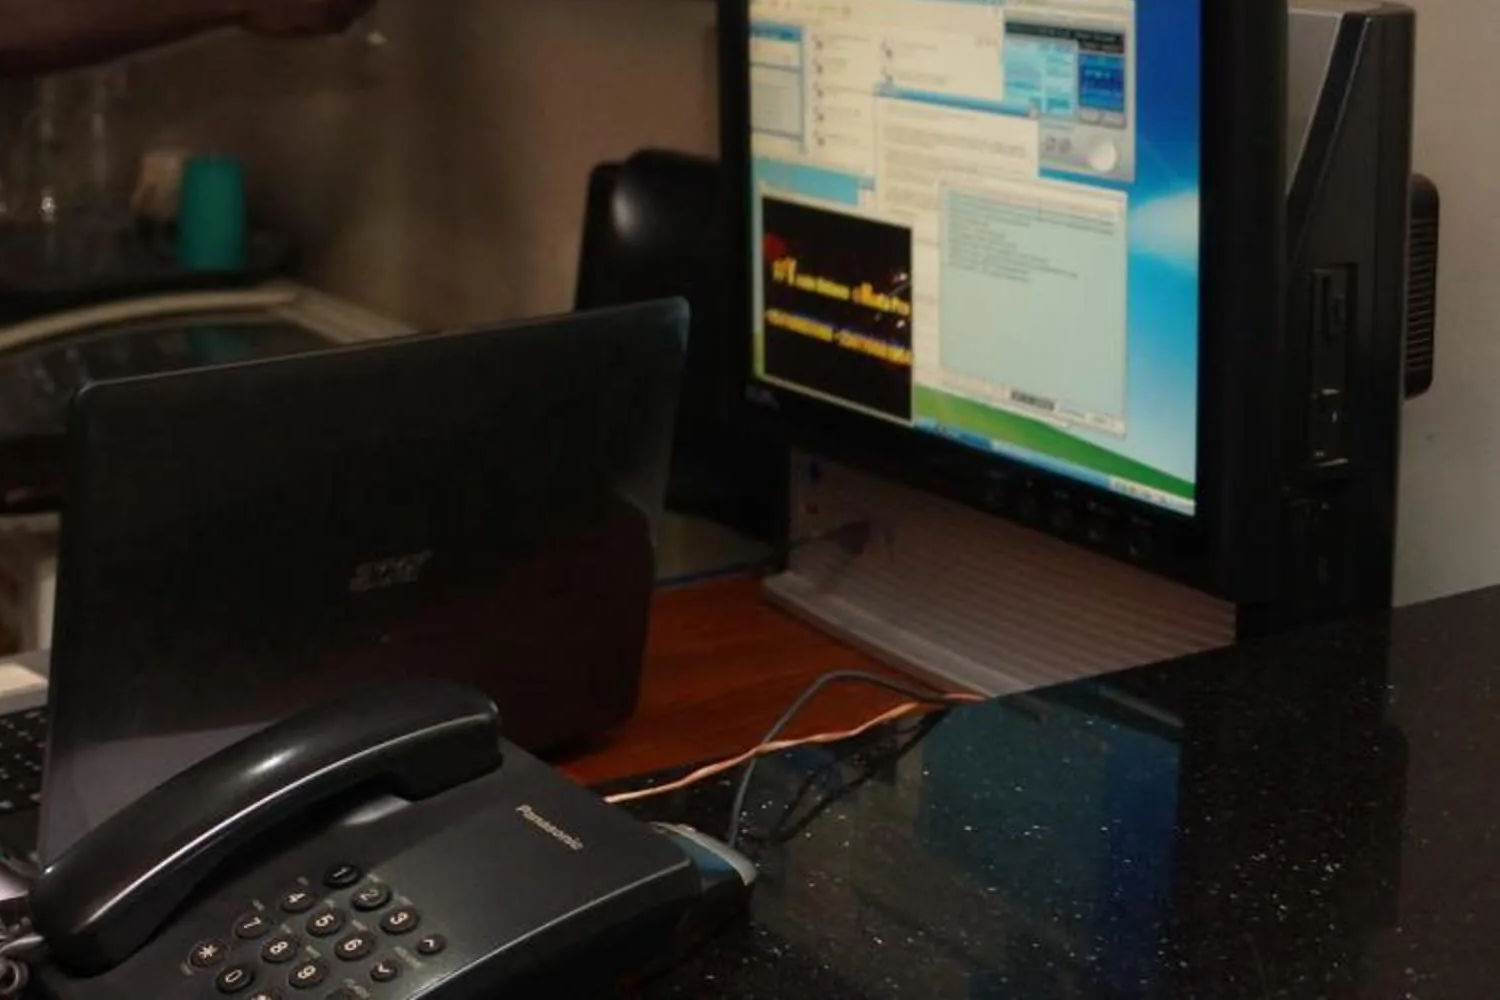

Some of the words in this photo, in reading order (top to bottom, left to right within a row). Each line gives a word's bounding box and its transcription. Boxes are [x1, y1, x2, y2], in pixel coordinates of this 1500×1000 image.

[515, 804, 583, 851] Panasonic
[333, 867, 348, 878] 1
[289, 891, 306, 904] 4
[359, 889, 379, 901] 2
[243, 918, 262, 930] 7
[315, 914, 335, 928] 5
[389, 912, 409, 926] 3
[269, 941, 288, 955] 8
[344, 938, 363, 952] 6
[297, 965, 317, 979] 9
